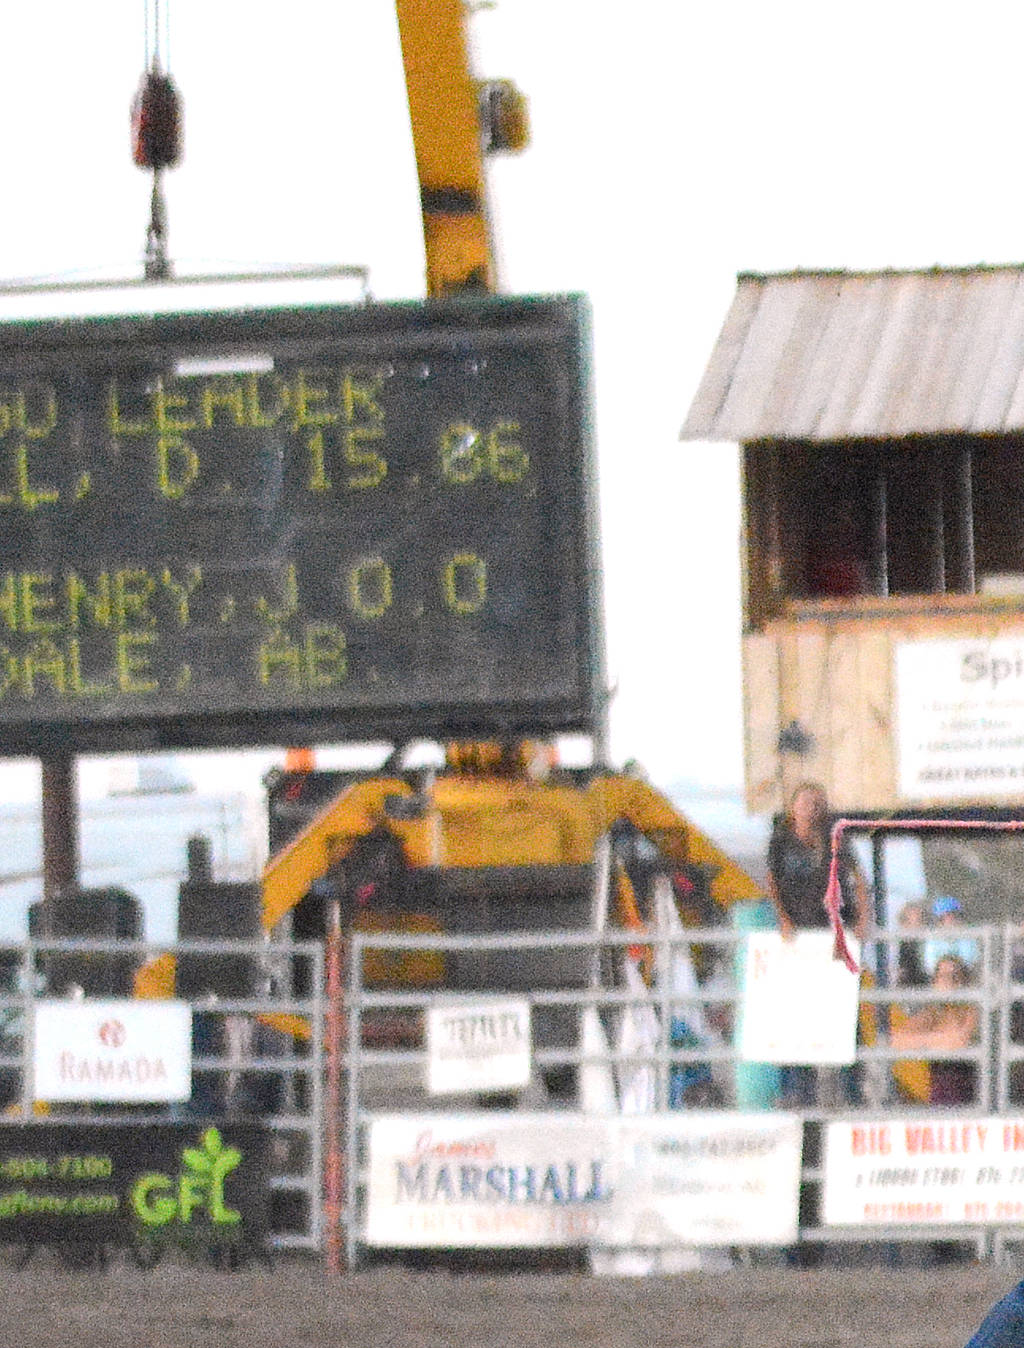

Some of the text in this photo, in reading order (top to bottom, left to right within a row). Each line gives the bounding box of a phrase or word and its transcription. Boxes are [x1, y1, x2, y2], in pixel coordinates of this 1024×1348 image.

[108, 372, 385, 433] LEADER
[59, 1049, 168, 1084] RAMADA
[851, 1126, 892, 1157] BIG
[904, 1124, 989, 1156] VALLEY
[132, 1160, 242, 1225] GFL
[395, 1158, 614, 1205] MARSHALL
